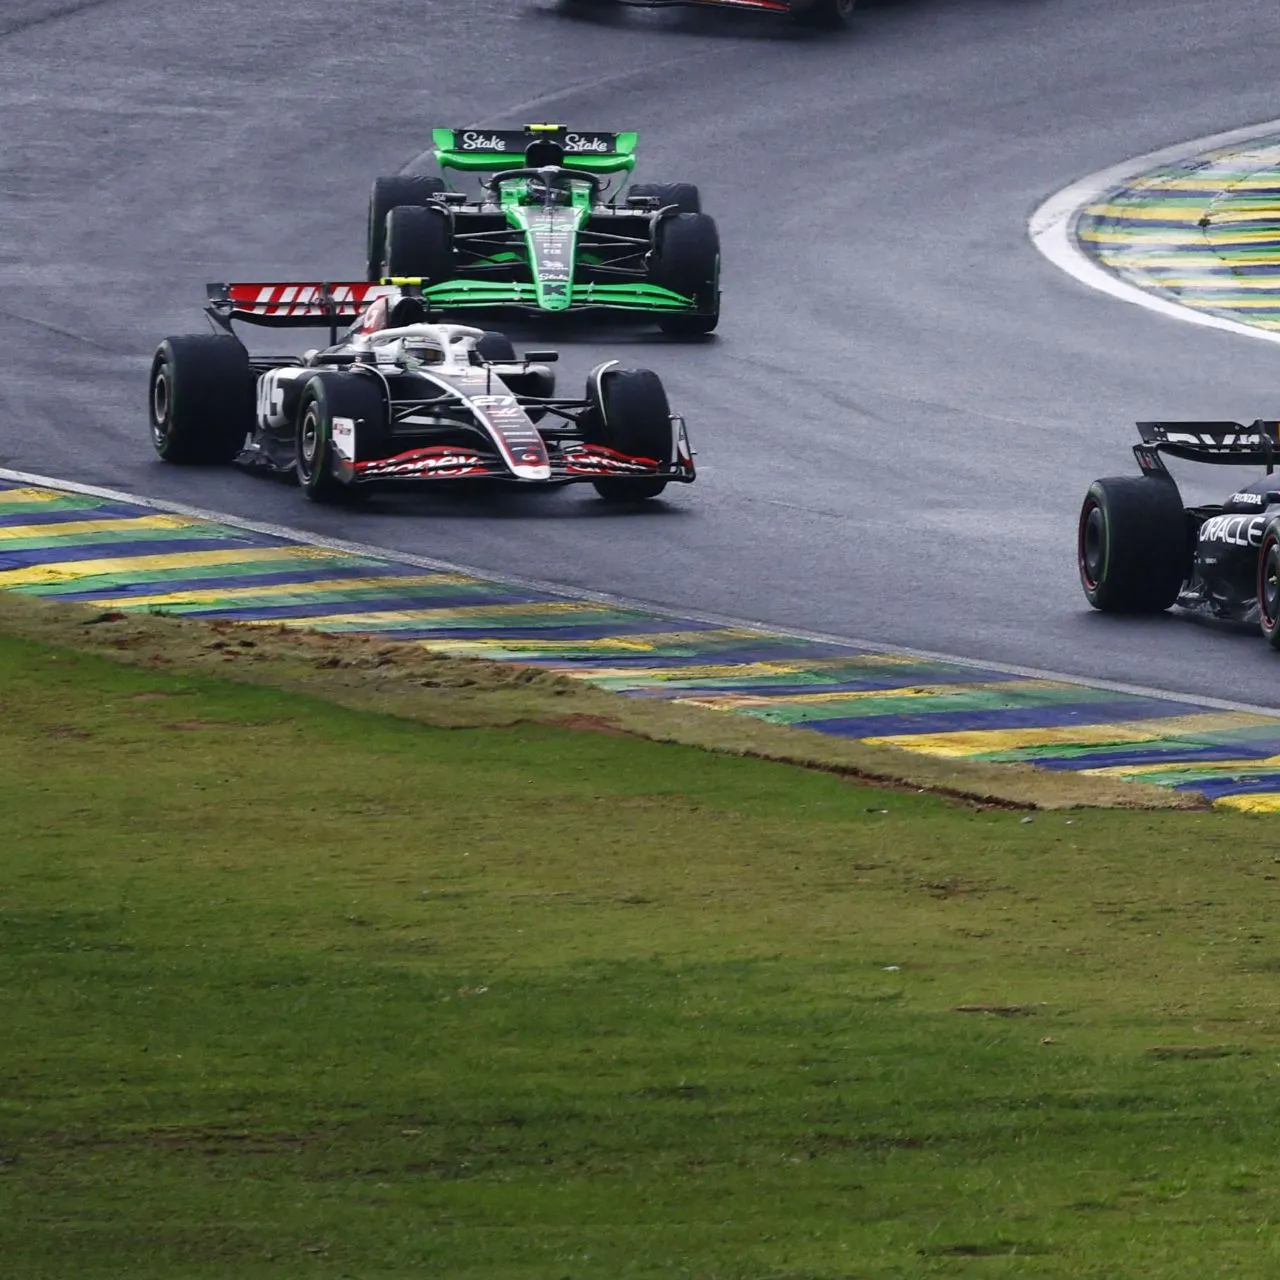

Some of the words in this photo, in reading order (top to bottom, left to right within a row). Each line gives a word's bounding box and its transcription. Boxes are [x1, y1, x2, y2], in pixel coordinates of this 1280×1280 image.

[462, 132, 507, 151] Stake
[565, 133, 608, 153] Stake
[1232, 492, 1262, 505] HONDA
[1200, 515, 1266, 548] ORACLE
